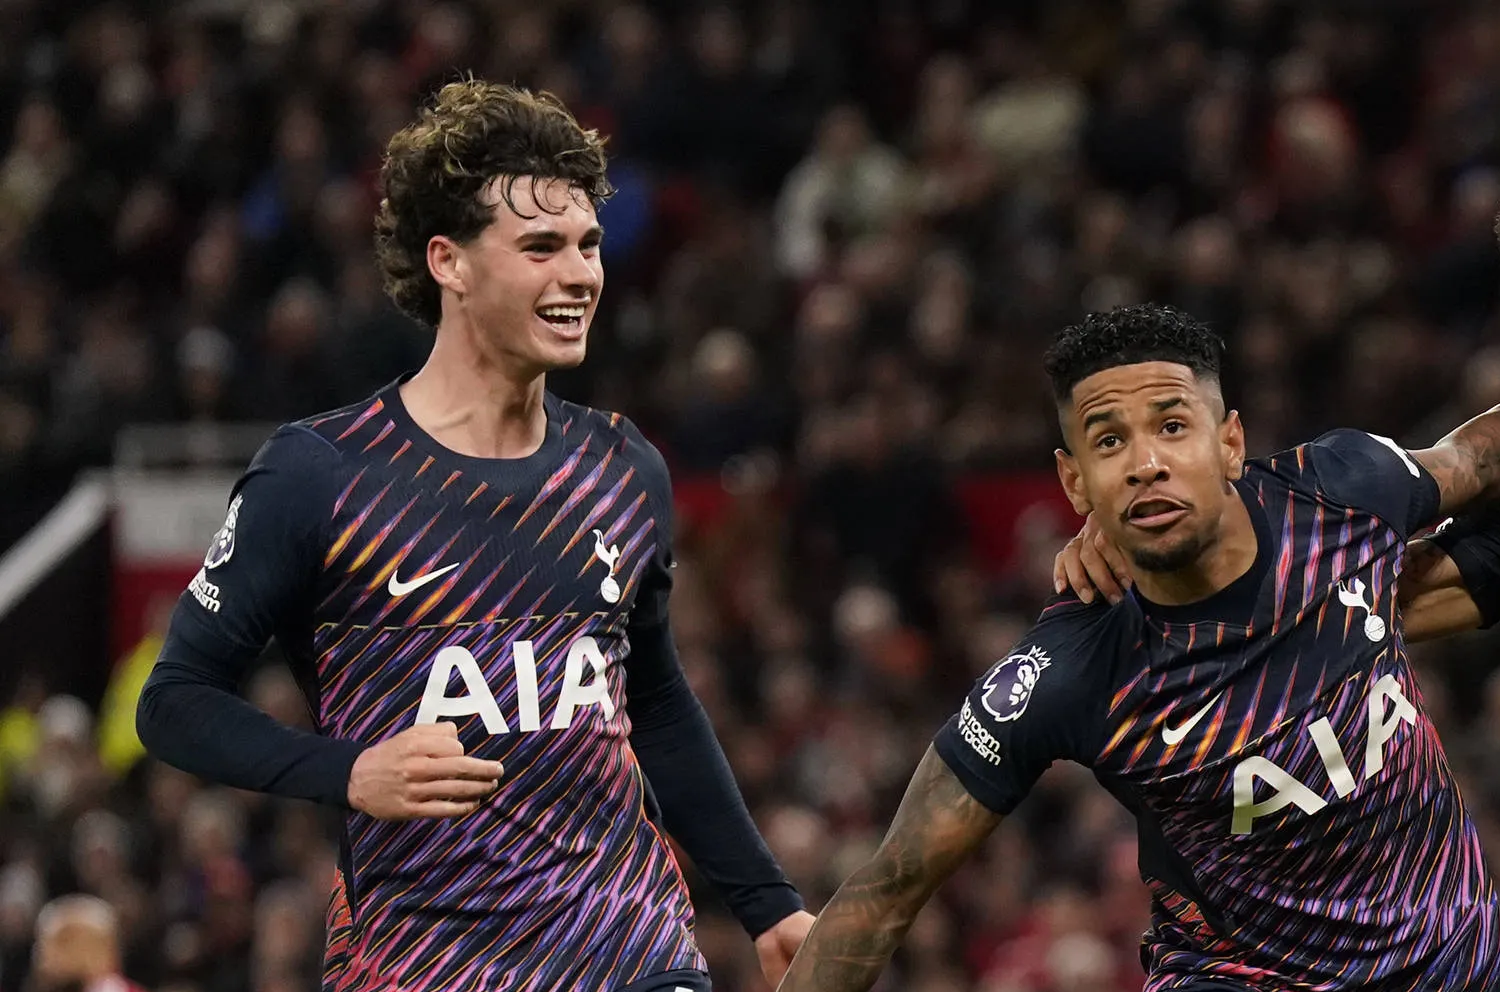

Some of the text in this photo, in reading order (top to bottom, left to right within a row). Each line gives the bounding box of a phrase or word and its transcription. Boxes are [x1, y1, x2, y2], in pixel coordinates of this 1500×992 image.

[414, 635, 615, 735] AIA
[961, 725, 1001, 765] racism
[968, 715, 1001, 752] room
[1231, 673, 1417, 834] AIA
